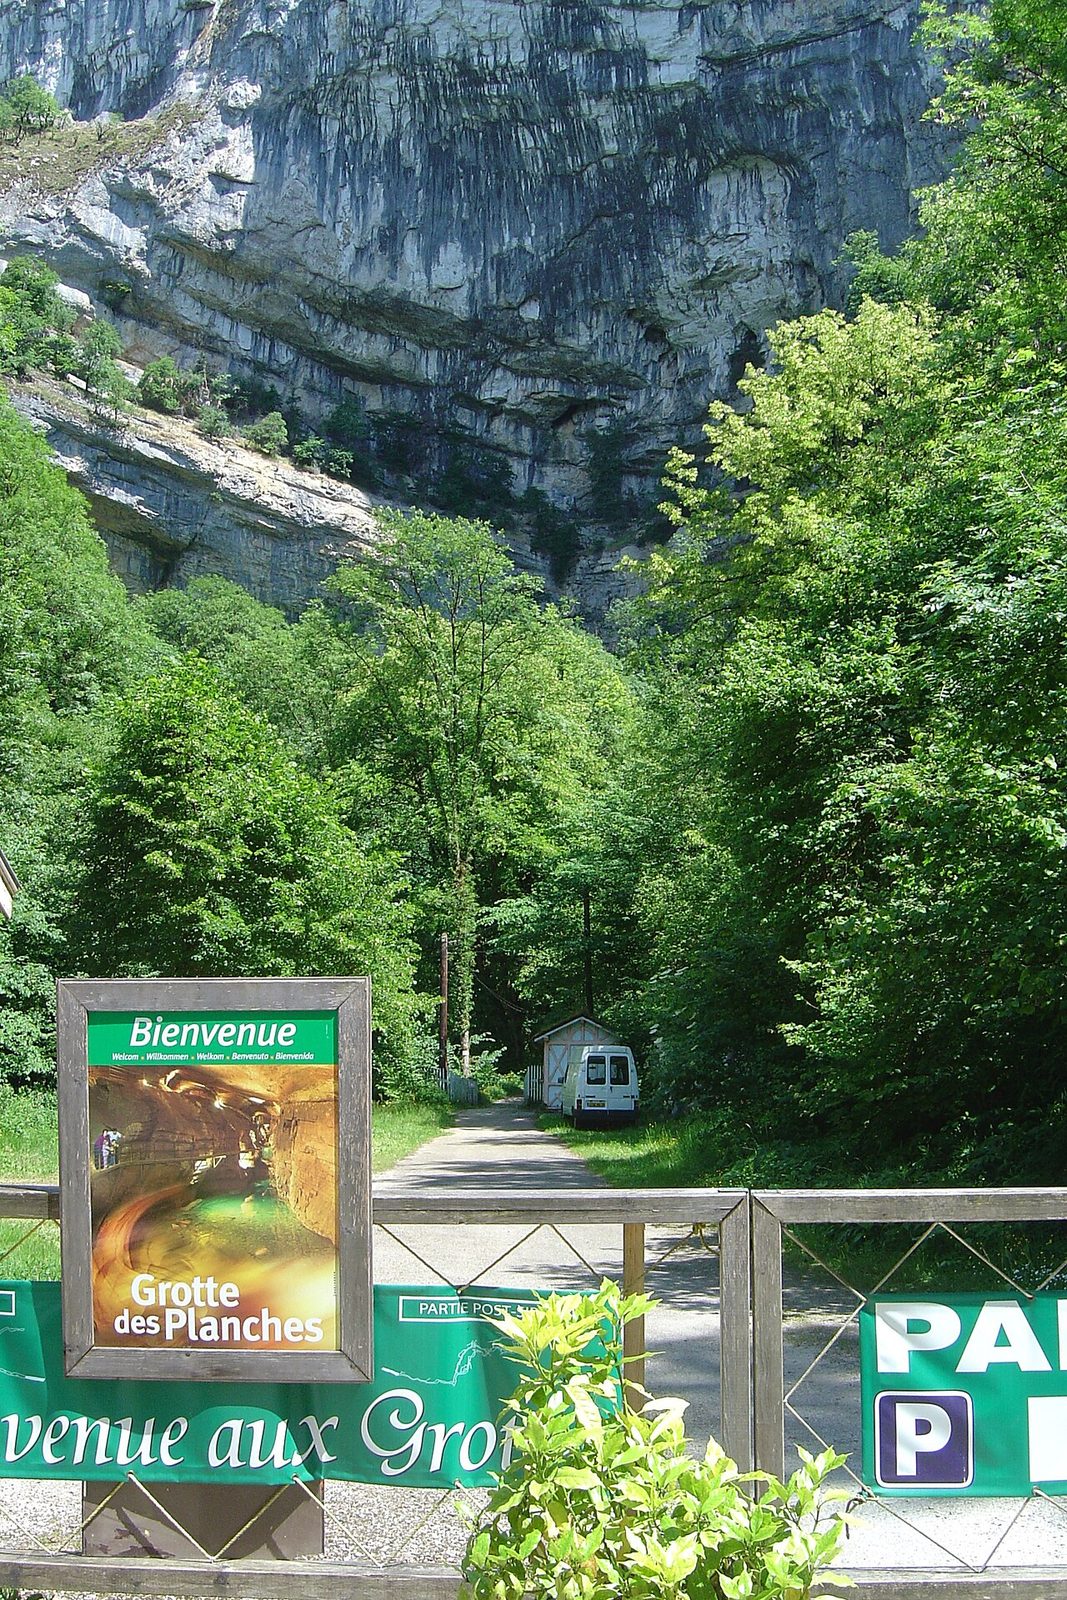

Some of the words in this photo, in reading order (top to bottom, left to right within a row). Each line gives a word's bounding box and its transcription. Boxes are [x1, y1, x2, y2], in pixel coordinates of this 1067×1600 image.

[129, 1016, 297, 1048] Bienvenue
[146, 1052, 189, 1061] Willkommen
[196, 1052, 225, 1061] Welkom
[231, 1052, 269, 1061] Benvenuto
[130, 1274, 240, 1308] Grotte
[419, 1302, 469, 1315] PARTIE
[114, 1309, 161, 1335] des
[165, 1307, 324, 1343] Planches
[875, 1299, 1067, 1373] PA
[208, 1415, 339, 1469] aux
[895, 1402, 952, 1476] P
